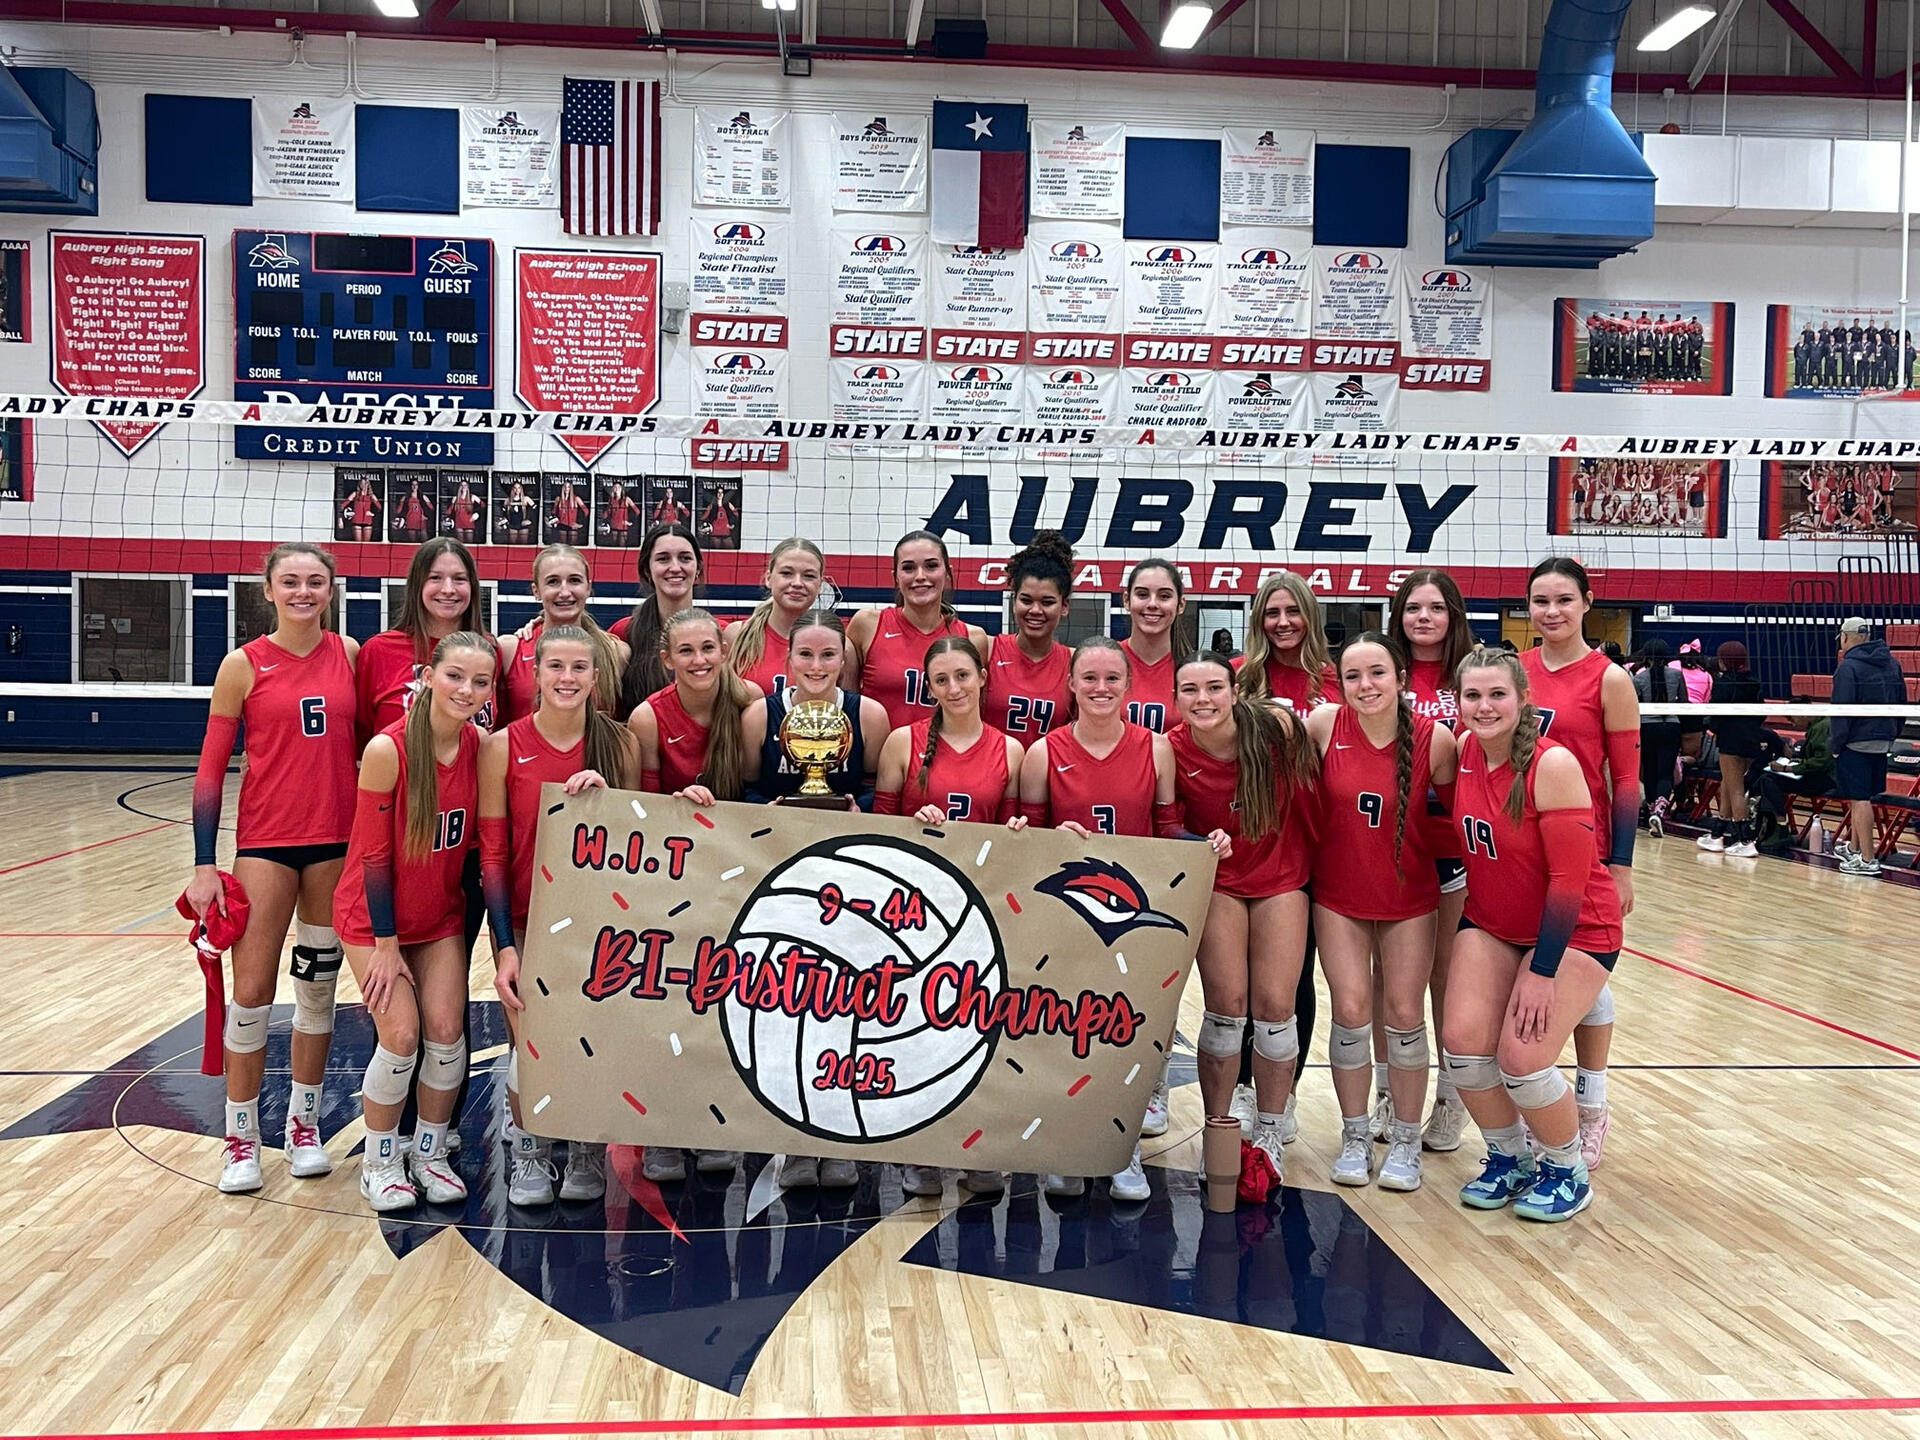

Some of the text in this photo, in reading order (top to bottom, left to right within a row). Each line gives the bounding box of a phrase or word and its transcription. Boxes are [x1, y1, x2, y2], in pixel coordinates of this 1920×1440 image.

[62, 243, 193, 255] Aubrey High School
[91, 256, 165, 267] Fight Song
[698, 253, 778, 262] Regional Champions
[529, 260, 648, 271] Aubrey High School
[700, 264, 775, 274] State Finalist
[842, 265, 915, 274] Regional Qualifiers
[945, 267, 1014, 277] State Champions
[83, 275, 125, 286] Aubrey!
[129, 277, 144, 285] Go
[147, 278, 189, 288] Aubrey!
[257, 273, 300, 288] HOME
[552, 270, 624, 280] Alma Mater
[346, 284, 381, 295] PERIOD
[424, 279, 471, 293] GUEST
[102, 298, 114, 306] it!
[118, 298, 136, 307] You
[161, 300, 174, 308] do
[177, 301, 189, 309] it!
[541, 292, 587, 301] Chaparrals,
[605, 294, 649, 302] Chaparrals
[845, 294, 912, 304] State Qualifier
[968, 305, 1012, 313] Runner-up
[1138, 306, 1202, 315] State Qualifiers
[606, 312, 633, 321] Pride,
[249, 327, 280, 337] FOULS
[293, 328, 319, 338] T.O.L.
[333, 330, 398, 341] PLAYER FOUL
[409, 332, 435, 342] T.O.L.
[447, 333, 478, 343] FOULS
[696, 320, 782, 343] STATE
[834, 329, 922, 353] STATE
[936, 336, 1020, 358] STATE
[1033, 339, 1115, 358] STATE
[1130, 341, 1211, 361] STATE
[1222, 344, 1304, 363] STATE
[95, 353, 163, 364] For VICTORY,
[1314, 346, 1395, 365] STATE
[249, 368, 281, 378] SCORE
[348, 371, 382, 381] MATCH
[447, 374, 478, 384] SCORE
[1405, 364, 1483, 383] STATE
[705, 384, 773, 394] State Qualifiers
[937, 381, 1012, 391] POWER LIFTING
[1132, 386, 1159, 394] TRACK
[1178, 387, 1200, 395] FIELD
[1156, 394, 1180, 402] 2012
[1228, 398, 1291, 406] POWERLIFTING
[1325, 399, 1378, 407] POWERLIFTING
[85, 399, 196, 418] CHAPS
[242, 404, 260, 420] A
[563, 403, 583, 411] High
[1134, 403, 1202, 414] State Qualifier
[306, 406, 657, 432] AUBREY LADY CHAPS
[1128, 417, 1207, 426] CHARLIE RADFORD
[702, 419, 719, 435] A
[763, 420, 1096, 444] AUBREY LADY CHAPS
[1137, 429, 1155, 445] A
[1199, 431, 1519, 451] AUBREY LADY CHAPS
[264, 434, 461, 456] CREDIT UNION
[1560, 436, 1578, 452] A
[1617, 437, 1920, 456] AUBREY LADY CHAP
[697, 443, 781, 462] STATE
[921, 475, 1477, 553] AUBREY
[300, 695, 327, 737] 6
[1007, 696, 1055, 734] 24
[1127, 702, 1166, 733] 10
[948, 793, 971, 821] 2
[1358, 792, 1383, 828] 9
[1091, 804, 1116, 835] 3
[432, 808, 466, 852] 18
[1462, 816, 1498, 859] 19
[572, 824, 694, 880] W.I.T
[925, 961, 1146, 1060] Champs
[815, 1049, 896, 1095] 2025
